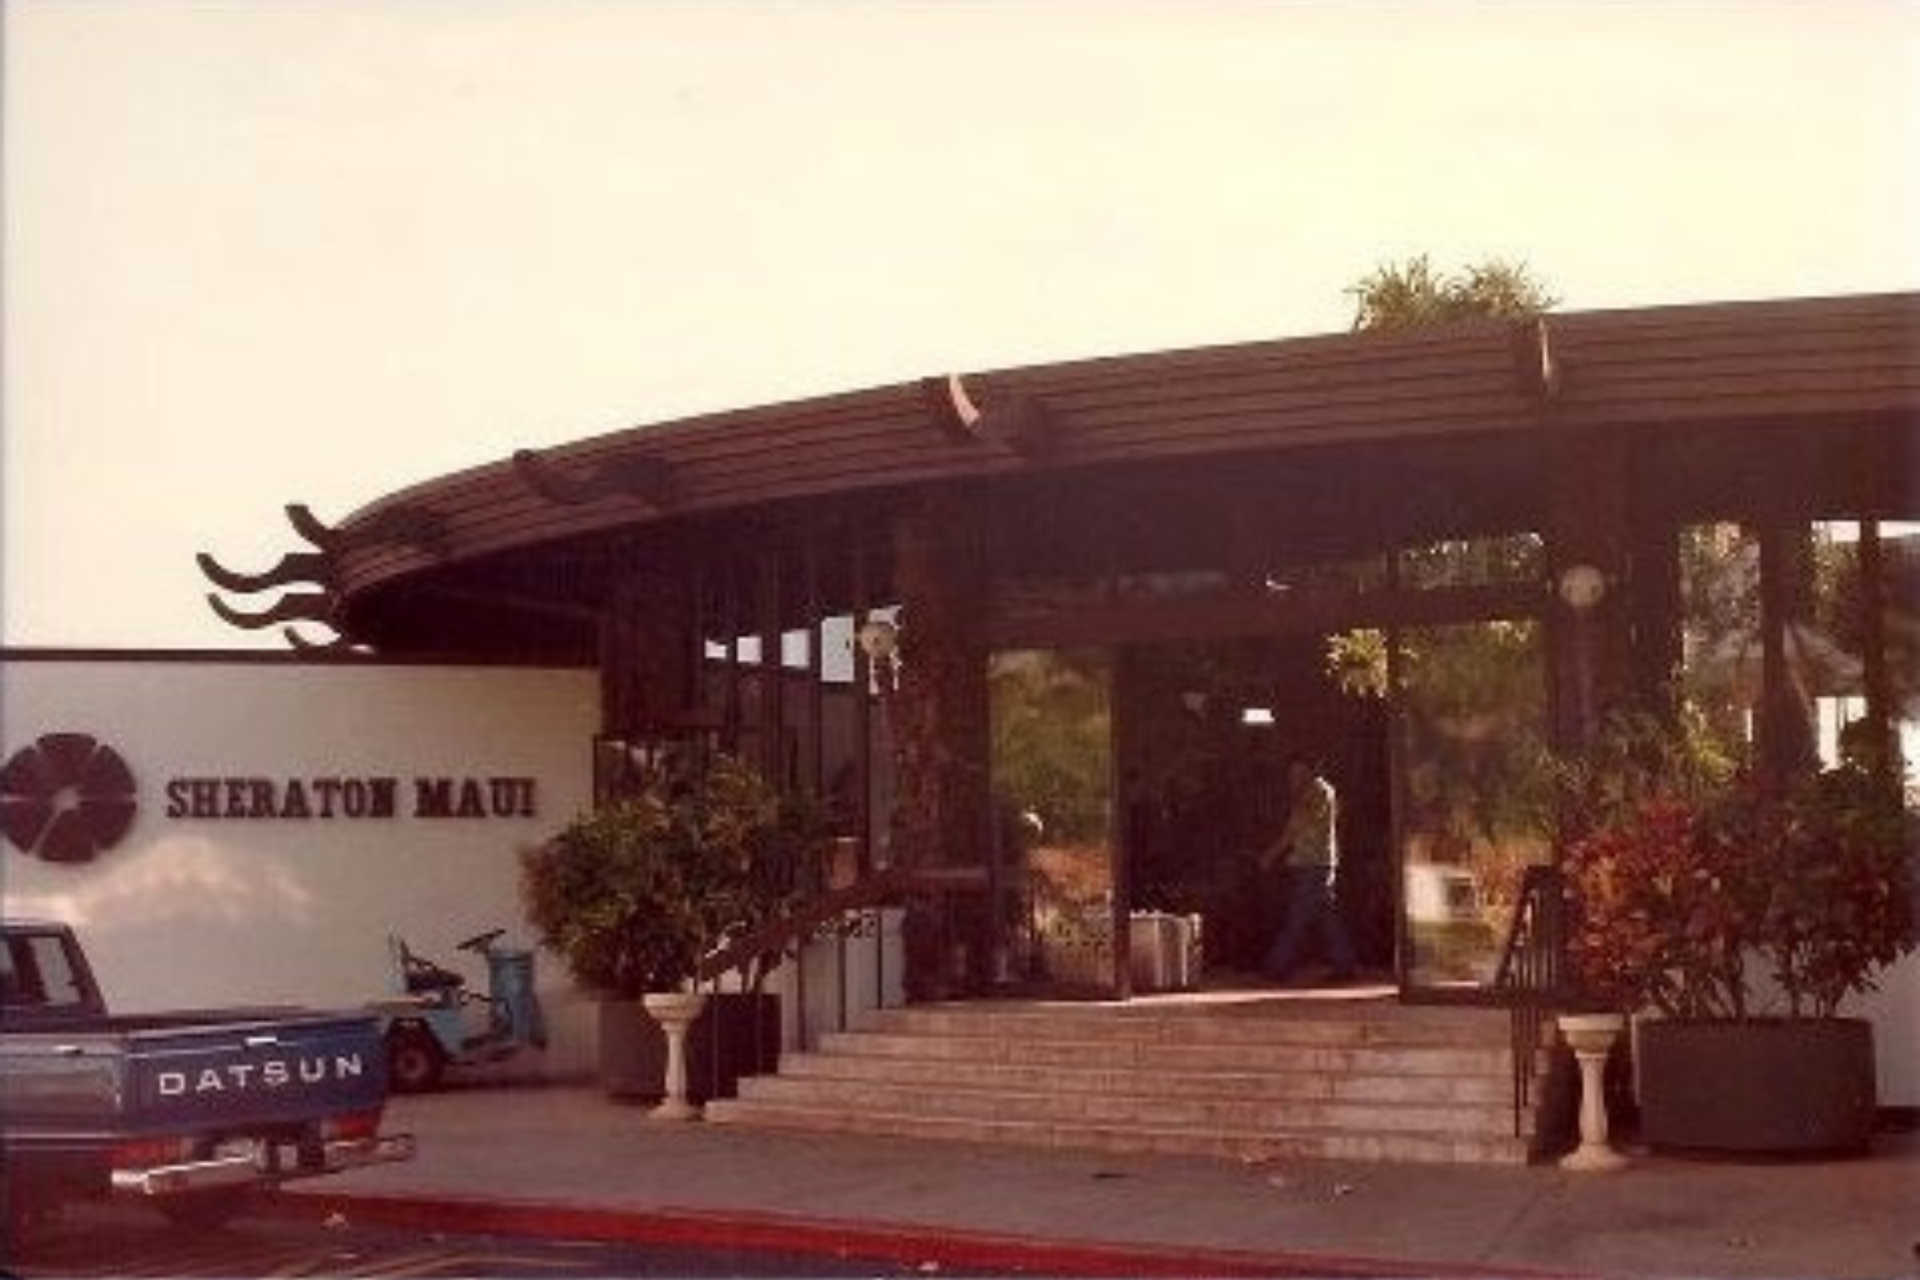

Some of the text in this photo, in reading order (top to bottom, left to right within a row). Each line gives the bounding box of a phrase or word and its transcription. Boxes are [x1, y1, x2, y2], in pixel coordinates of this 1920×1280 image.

[166, 777, 538, 818] SHERATON MAUI
[159, 1052, 364, 1096] DATSUN
